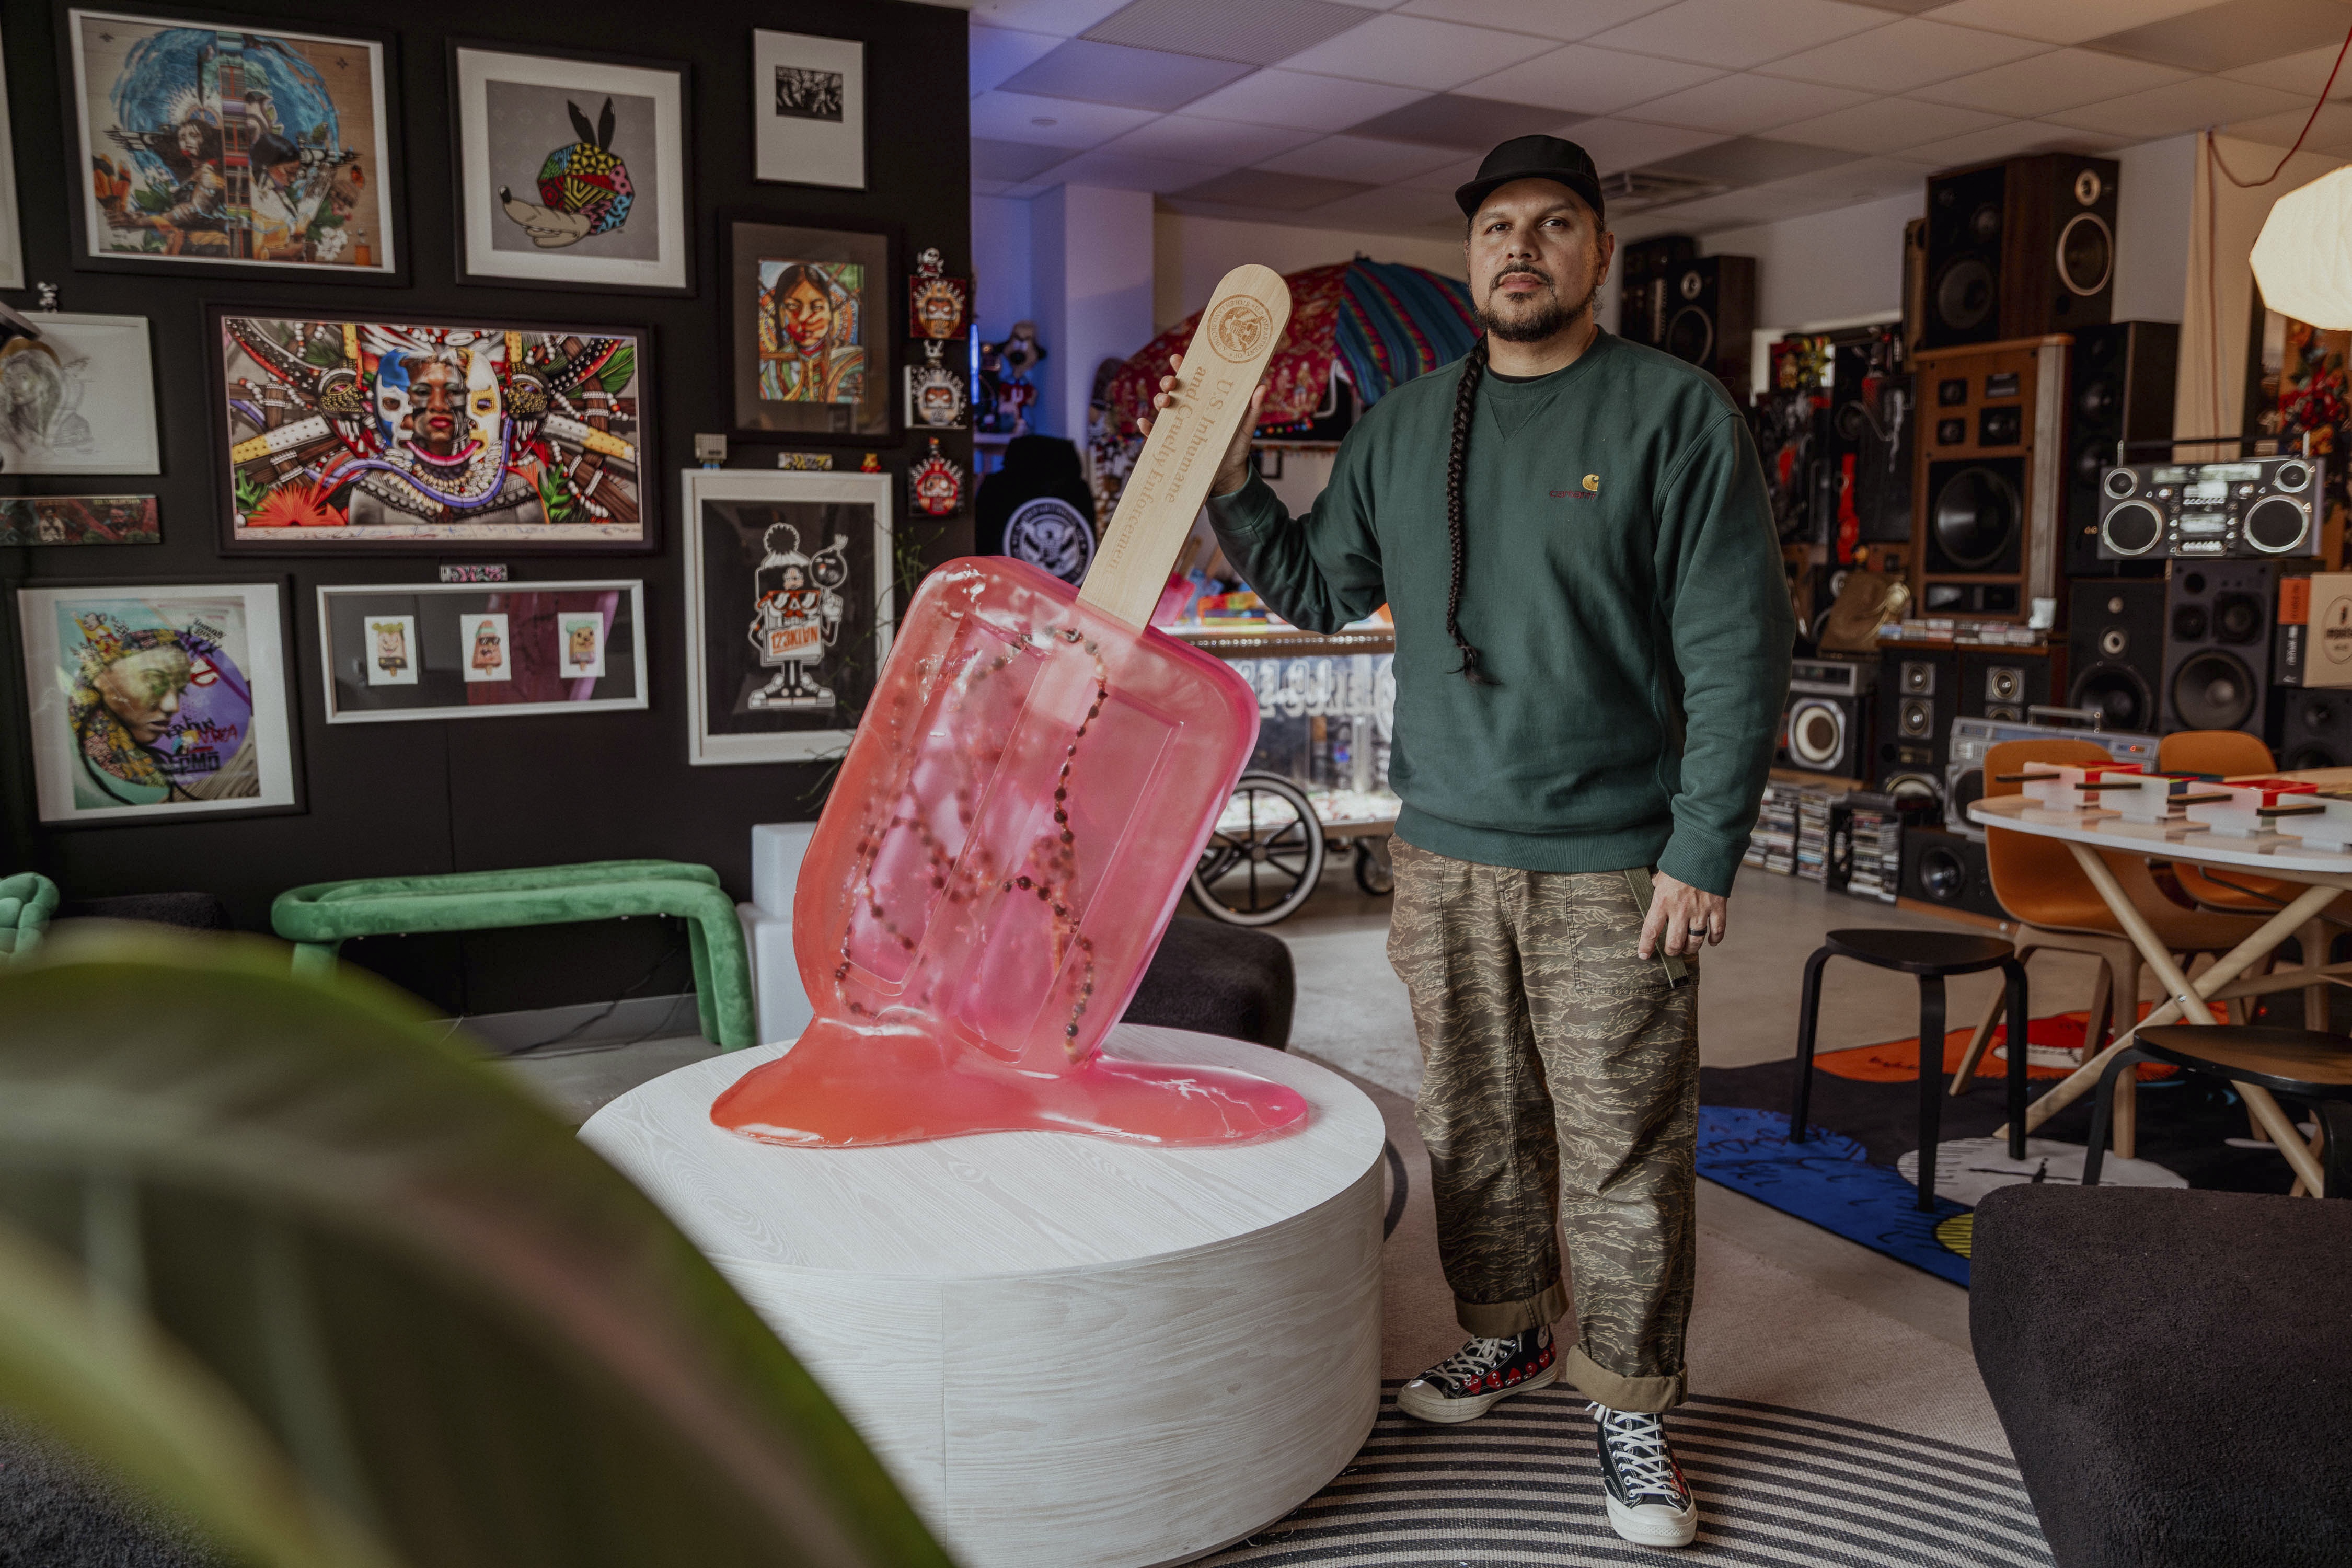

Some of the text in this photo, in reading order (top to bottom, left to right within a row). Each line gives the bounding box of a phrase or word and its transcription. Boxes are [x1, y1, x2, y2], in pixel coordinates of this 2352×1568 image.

[1186, 366, 1206, 401] and
[1152, 404, 1193, 467] Cruelty
[1166, 379, 1234, 503] U.S. Inhumane
